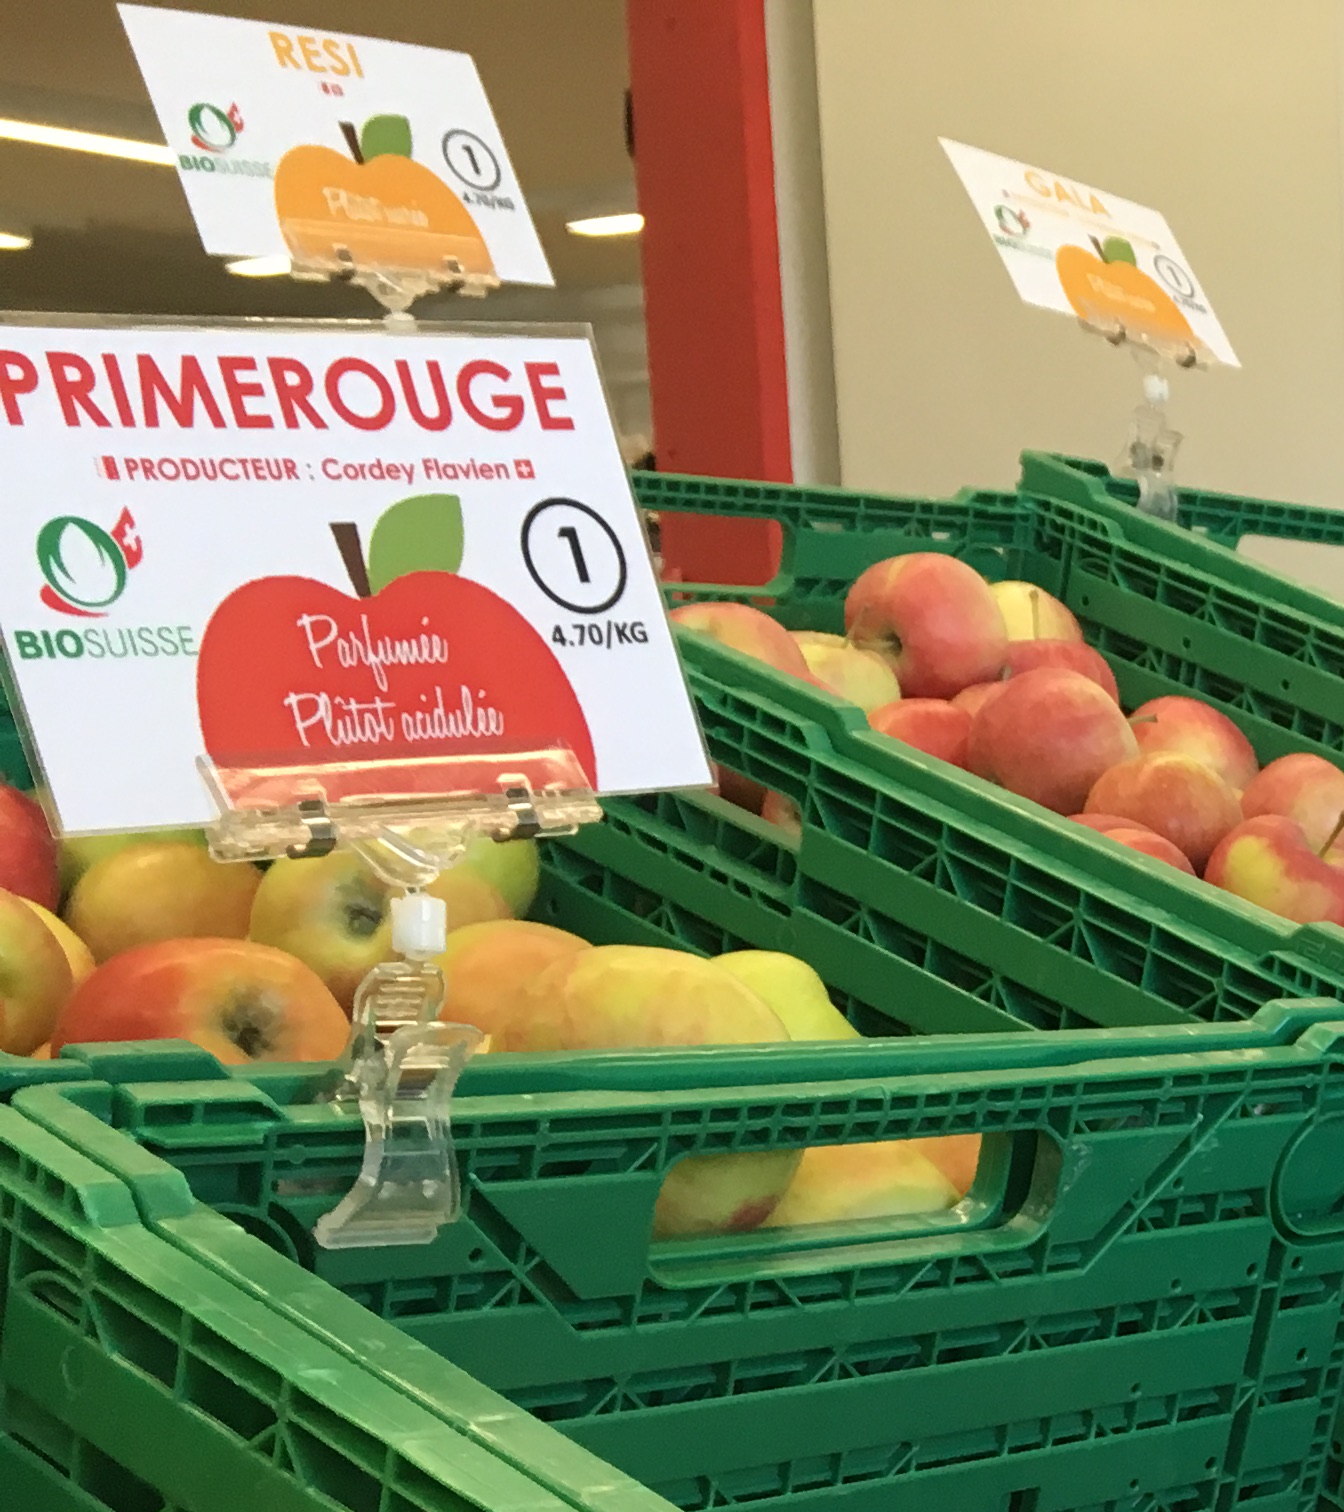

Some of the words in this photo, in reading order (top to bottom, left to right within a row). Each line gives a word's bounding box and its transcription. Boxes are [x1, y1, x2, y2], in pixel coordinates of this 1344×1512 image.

[268, 31, 364, 78] RESI
[462, 145, 481, 175] 1
[1023, 170, 1112, 218] GALA
[0, 349, 575, 432] PRIMEROUGE
[124, 457, 300, 480] PRODUCTEUR
[321, 459, 414, 484] Cordey
[423, 458, 510, 480] Flavien
[558, 526, 590, 583] 1
[551, 621, 648, 648] 4.70/KG
